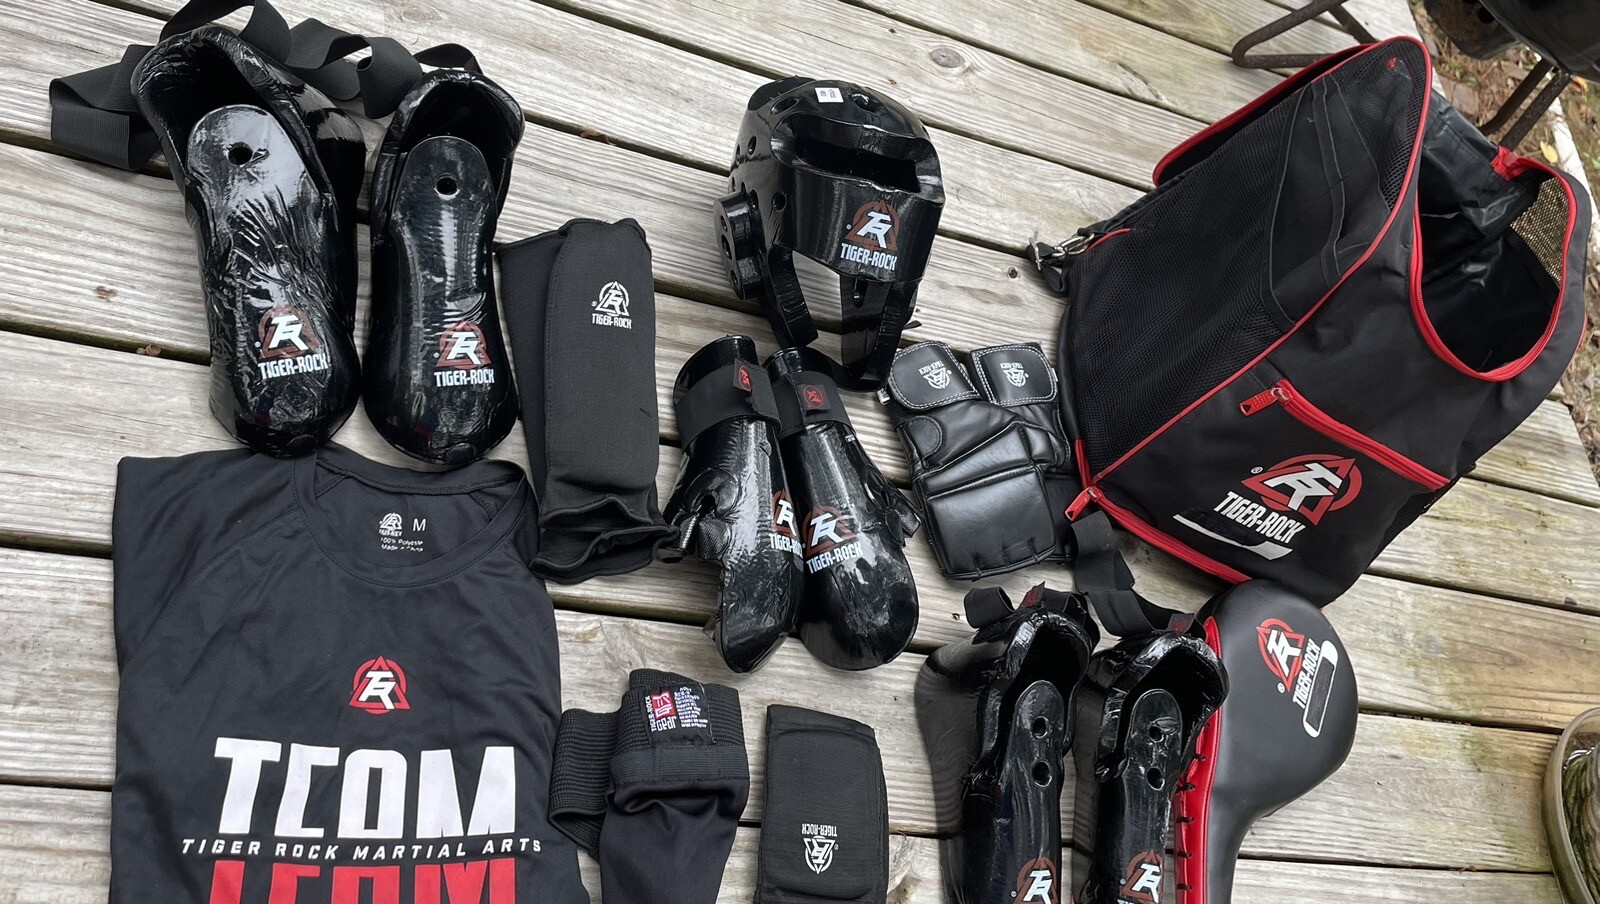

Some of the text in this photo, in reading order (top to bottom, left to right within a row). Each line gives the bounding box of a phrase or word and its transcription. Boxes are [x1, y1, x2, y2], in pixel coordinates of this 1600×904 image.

[840, 243, 898, 271] TIGER-ROCK
[591, 313, 632, 330] TIGER-ROCK
[257, 352, 329, 380] TIGER-ROCK
[433, 368, 495, 388] TIGER-ROCK
[412, 518, 427, 532] M
[1213, 491, 1306, 544] TIGER-ROCK
[806, 542, 864, 574] TIGER-ROCK
[1292, 637, 1321, 709] TIGER-ROCK
[801, 823, 838, 837] TIGER-ROCK
[182, 837, 541, 861] TIGER ROCK MARTIAL ARTS
